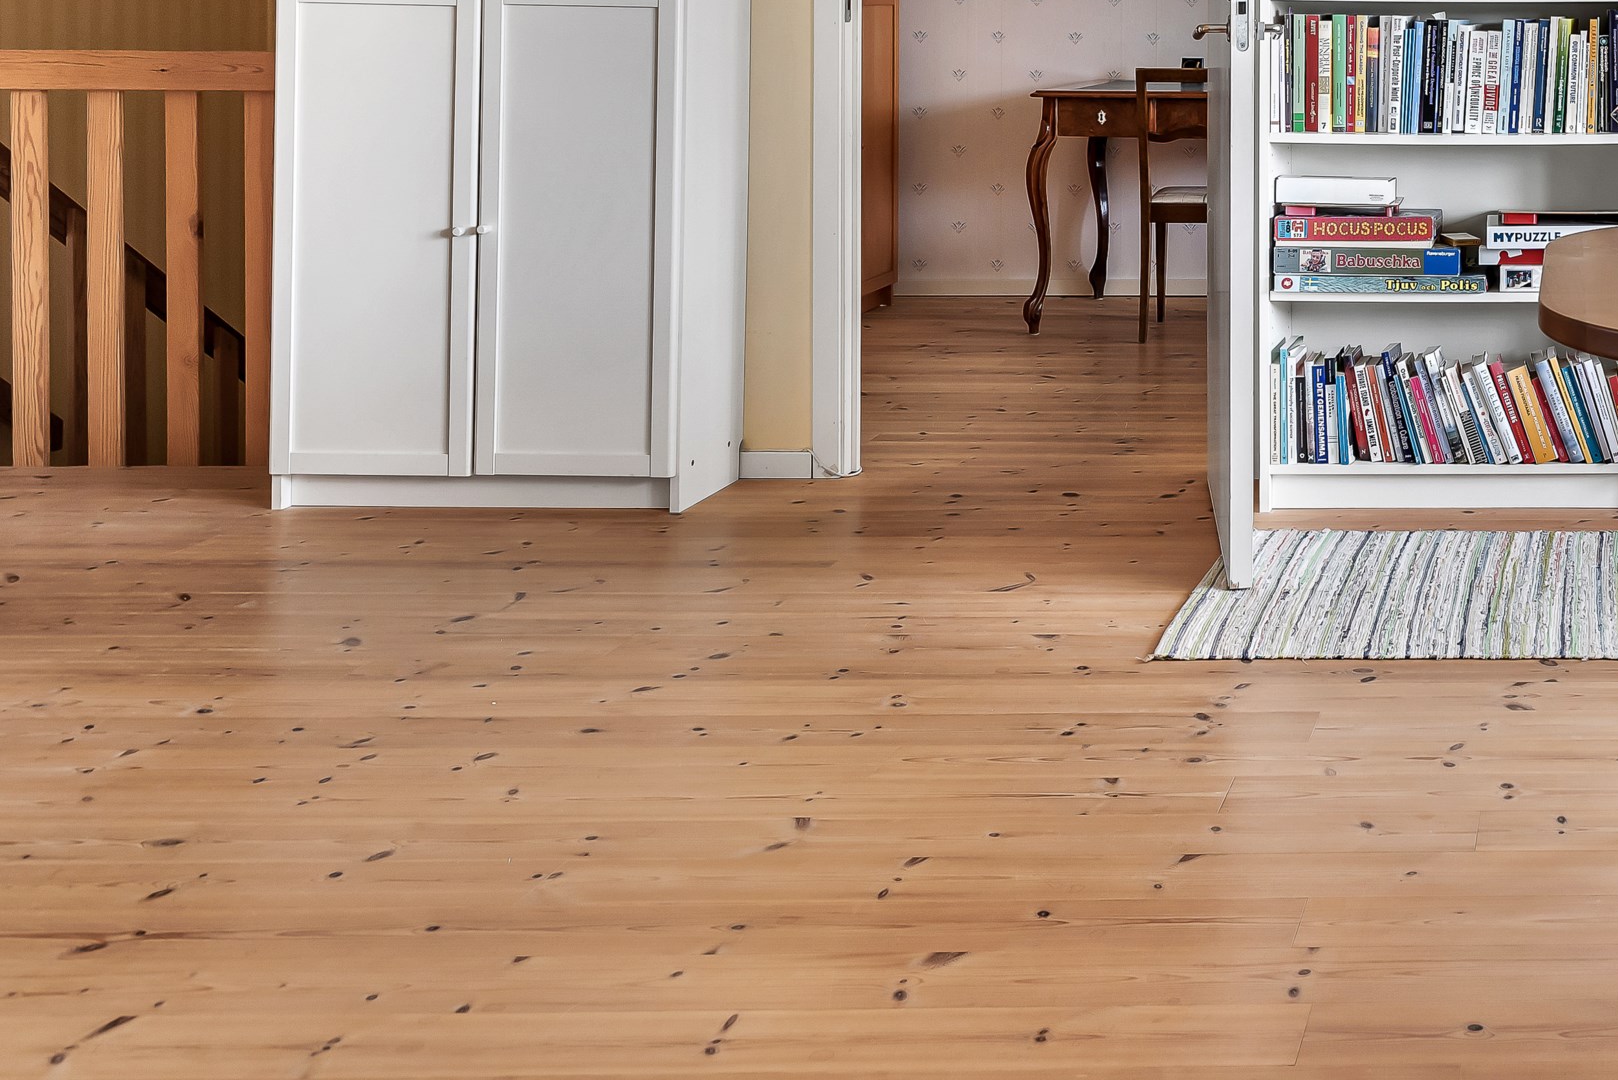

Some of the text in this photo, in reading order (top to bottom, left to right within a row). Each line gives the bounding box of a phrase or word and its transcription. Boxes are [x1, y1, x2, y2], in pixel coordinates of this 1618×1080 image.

[1391, 35, 1402, 102] The Post-Corporate World
[1472, 62, 1481, 77] PRICE
[1486, 60, 1496, 110] GREAT DIVIDE
[1469, 88, 1478, 121] INEQUALITY
[1336, 253, 1421, 268] Babuschka
[1385, 279, 1417, 292] Tjuv
[1440, 279, 1479, 291] Polis
[1480, 369, 1505, 424] PRICELESS
[1496, 375, 1506, 390] PRICE
[1317, 399, 1325, 456] GEMENSAMMA
[1357, 370, 1377, 448] PRIVATE ISLAND JAMES MEEK
